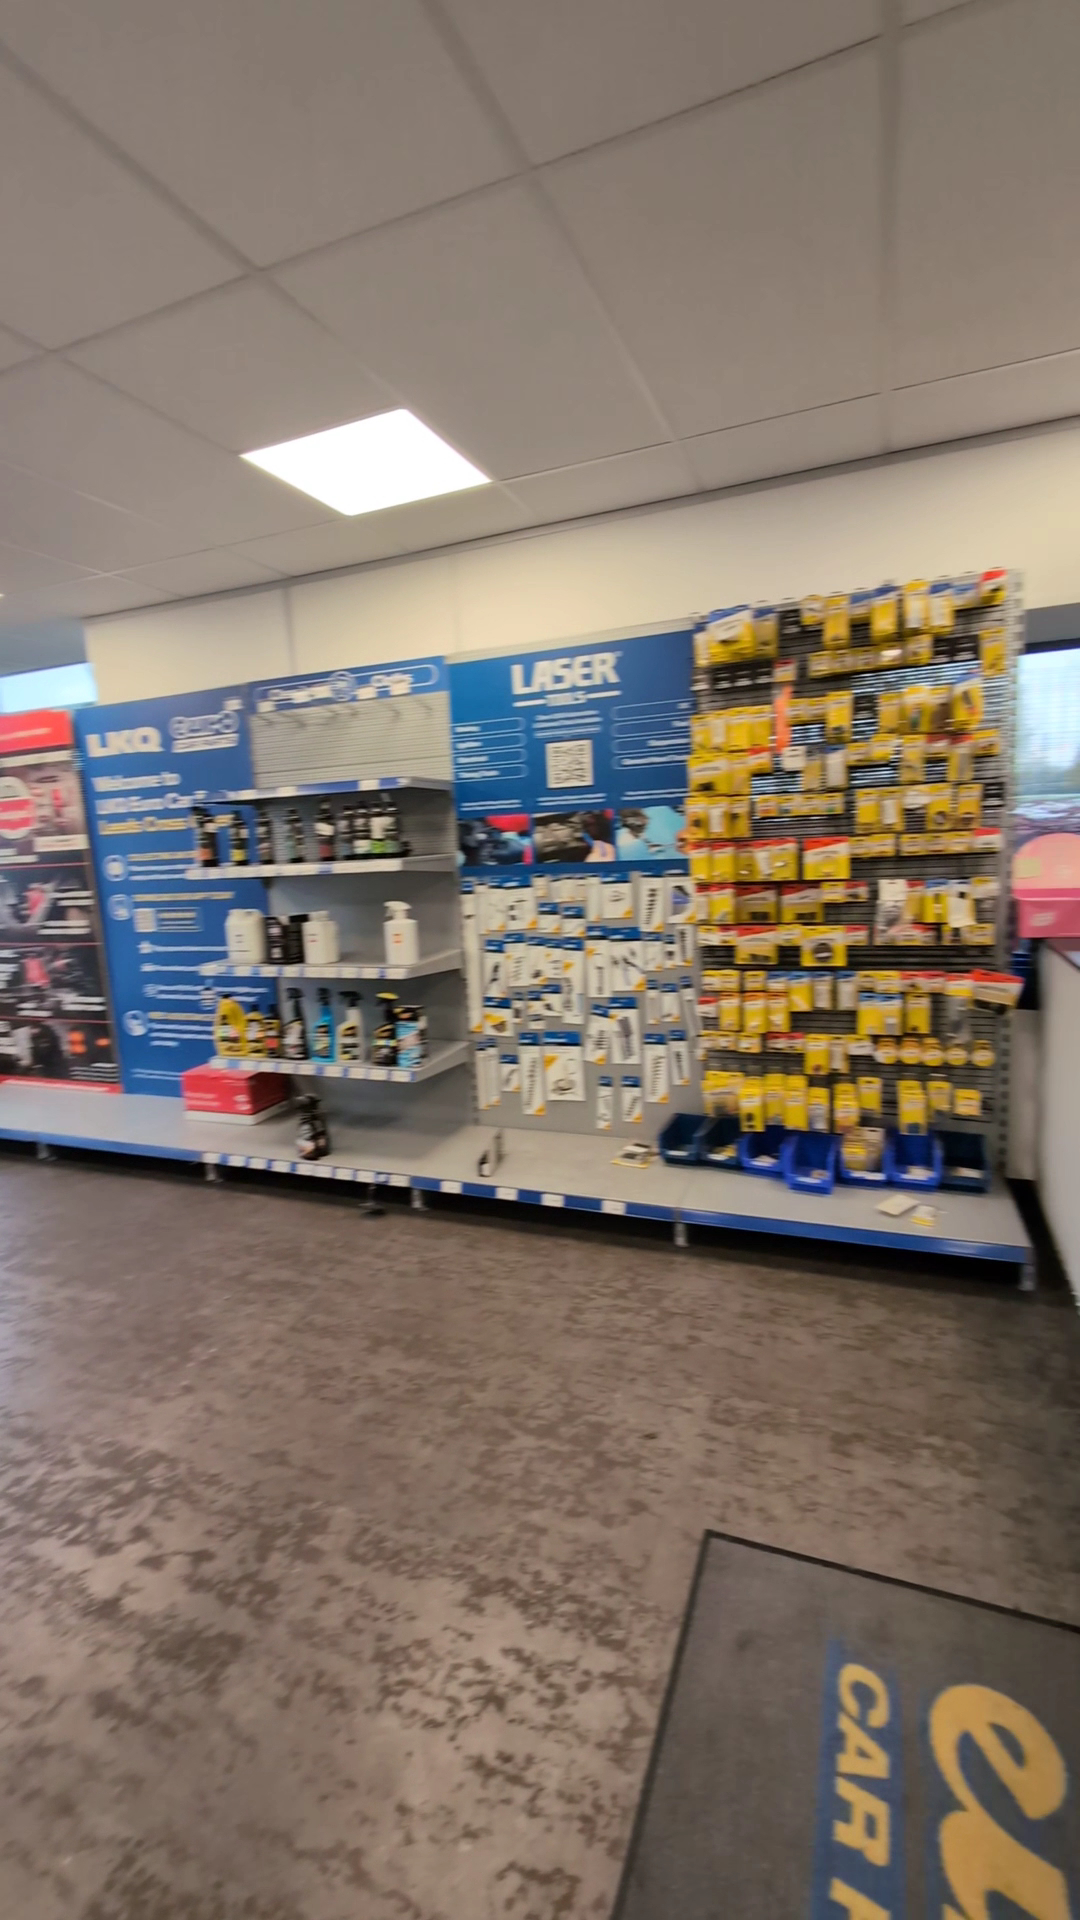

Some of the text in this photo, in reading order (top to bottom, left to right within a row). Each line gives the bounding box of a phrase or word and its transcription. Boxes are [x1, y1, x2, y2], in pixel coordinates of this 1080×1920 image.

[510, 651, 622, 695] LASER
[85, 726, 165, 758] LKQ
[91, 771, 182, 792] Welcome to
[832, 1663, 890, 1867] CAR
